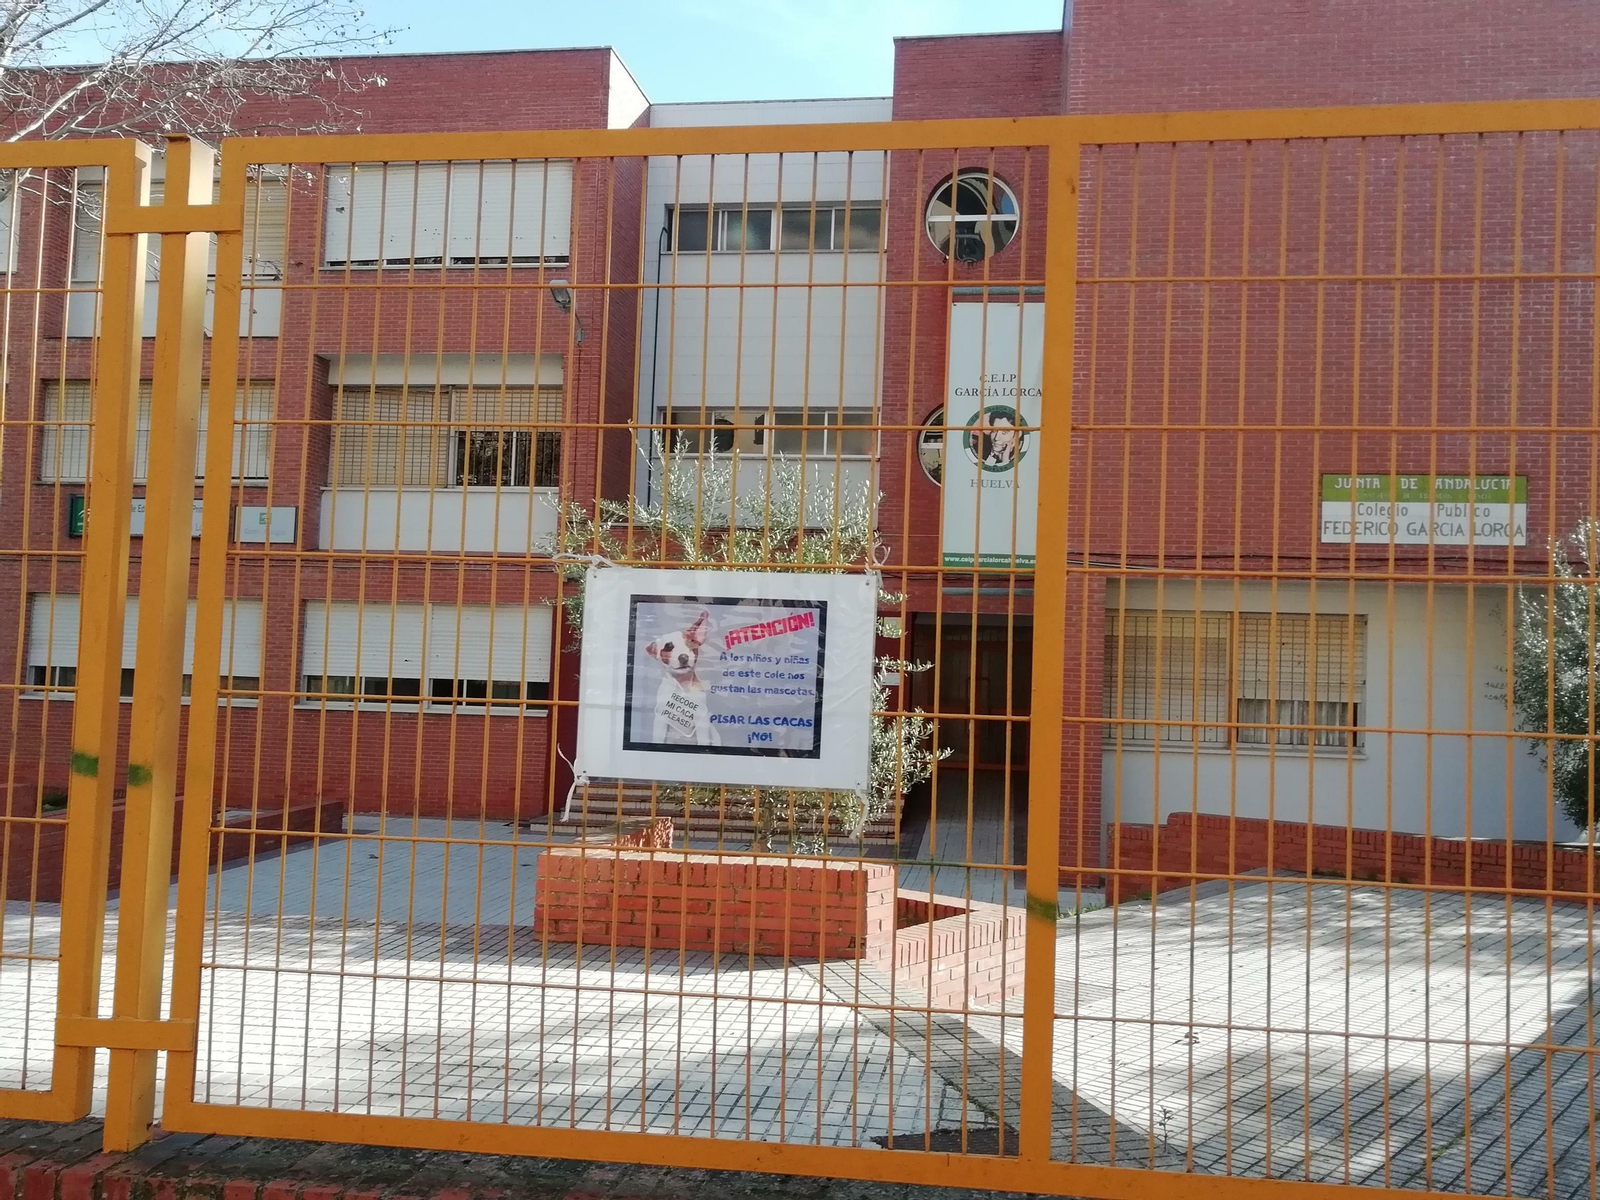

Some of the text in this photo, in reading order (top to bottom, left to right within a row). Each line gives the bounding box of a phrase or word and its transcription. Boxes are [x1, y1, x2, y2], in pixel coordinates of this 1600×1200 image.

[1002, 387, 1043, 397] LORCA
[1334, 477, 1381, 489] JUNTA
[1400, 478, 1418, 489] DE
[1357, 502, 1491, 519] Colegio Publco
[1323, 520, 1525, 538] FEDERICO GARCIA LORCA
[724, 611, 815, 651] ¡ATENCIÓN!
[719, 651, 810, 665] A los niños y niñas
[722, 668, 736, 677] de
[738, 669, 762, 678] este
[788, 672, 805, 680] nos
[710, 684, 746, 694] gustan
[747, 685, 762, 694] las
[670, 692, 699, 711] RECOGE
[665, 700, 695, 720] MI CACA
[660, 709, 692, 729] ¡PLEASE!
[709, 714, 813, 727] PISAR LAS CACAS
